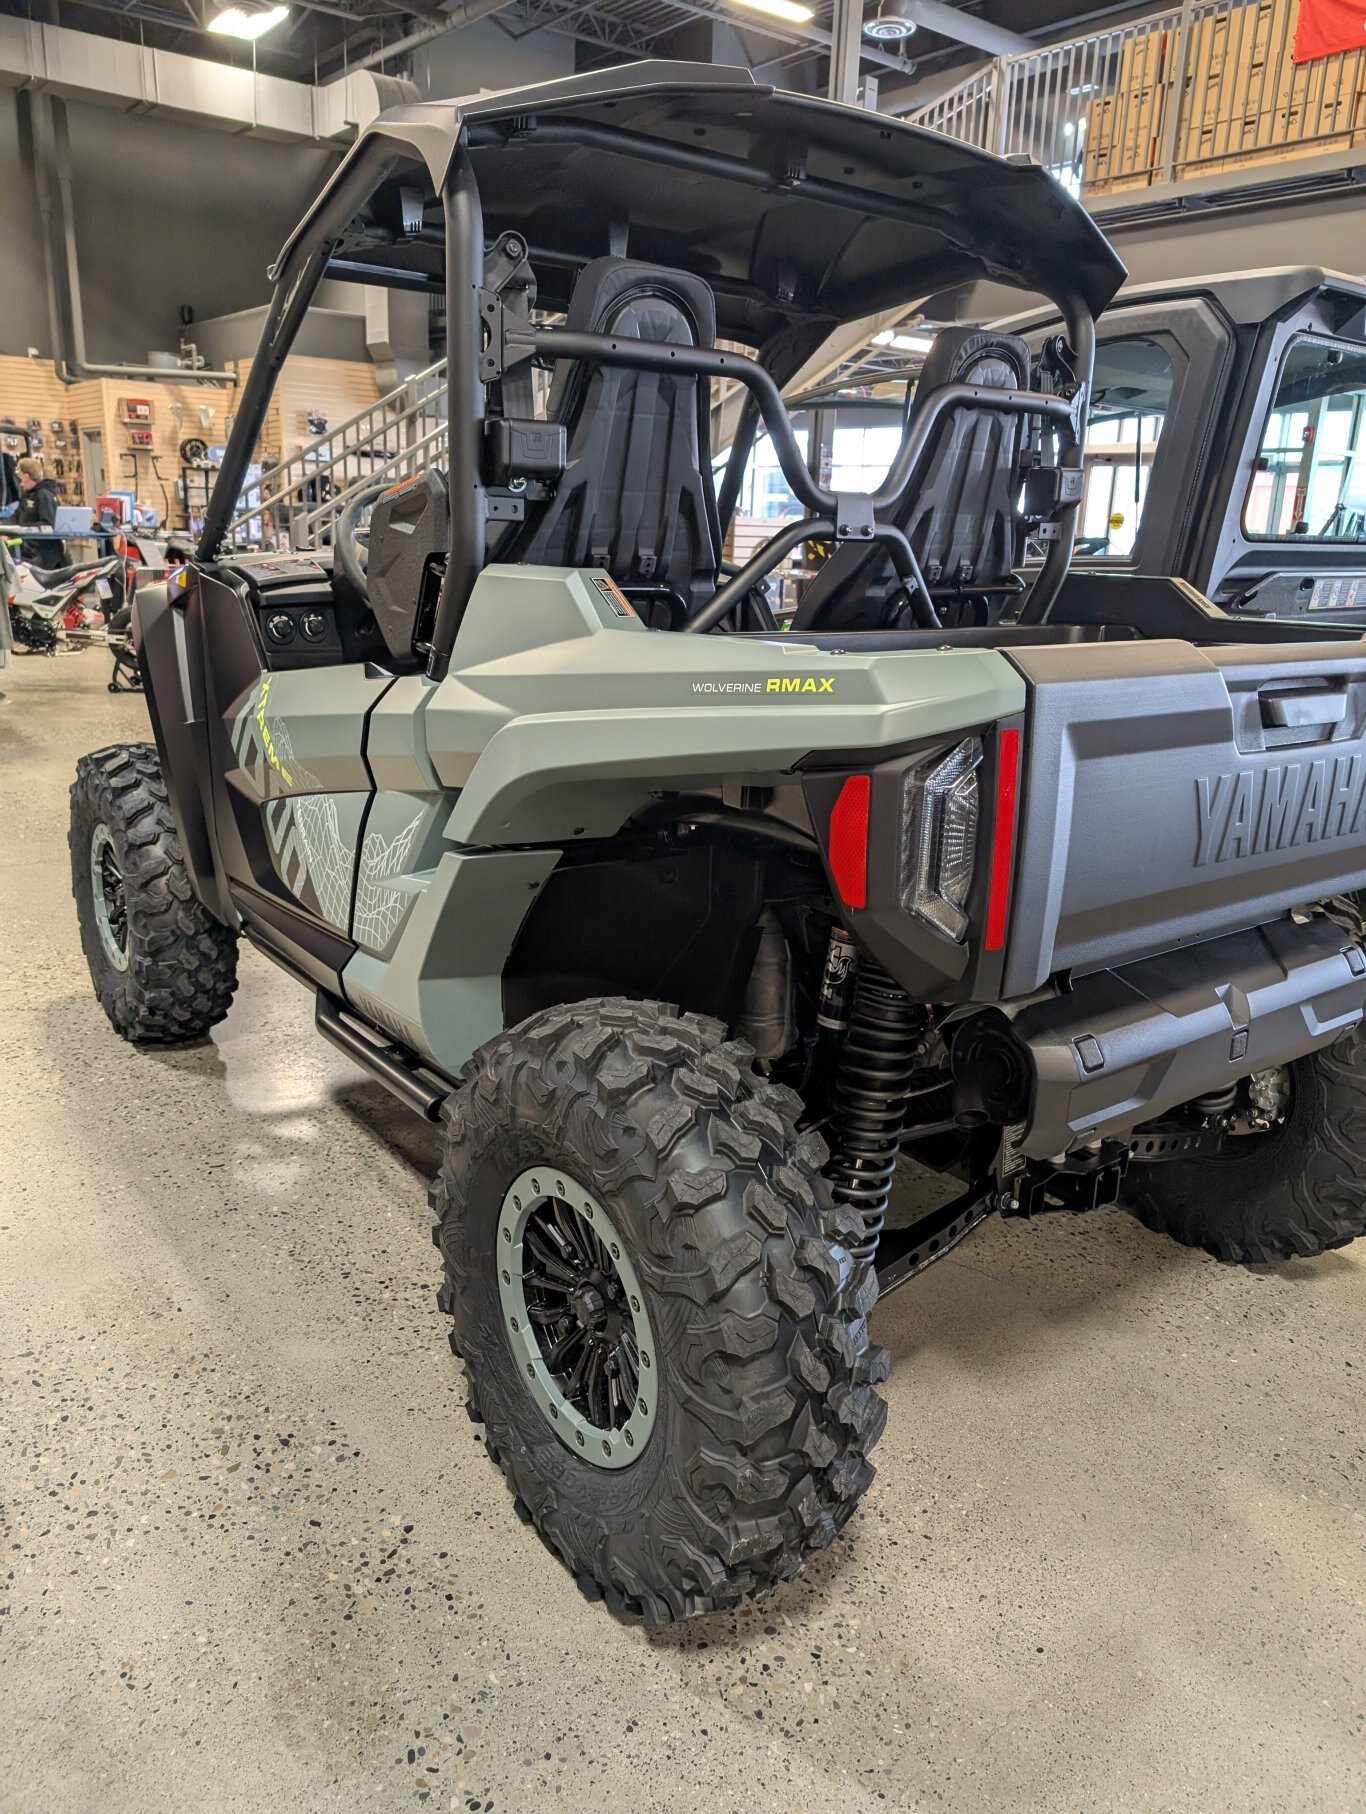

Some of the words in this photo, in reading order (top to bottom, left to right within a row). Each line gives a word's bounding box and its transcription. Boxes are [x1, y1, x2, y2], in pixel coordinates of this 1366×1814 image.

[692, 683, 762, 693] WOLVERINE
[766, 678, 835, 693] RMAX
[1194, 754, 1366, 867] YAMAH
